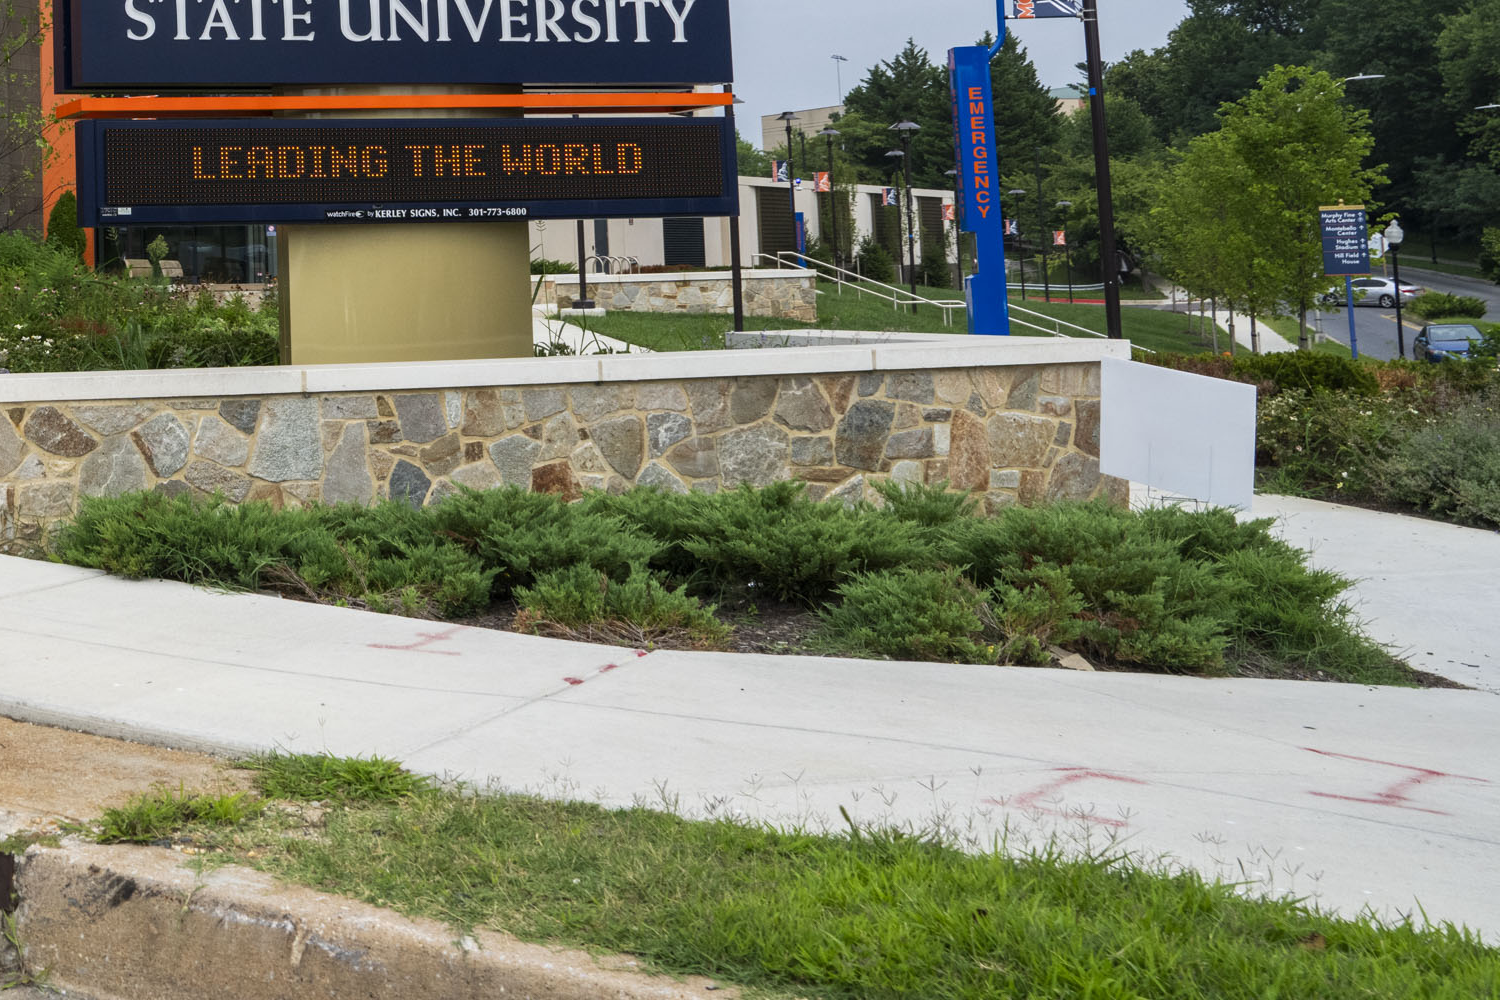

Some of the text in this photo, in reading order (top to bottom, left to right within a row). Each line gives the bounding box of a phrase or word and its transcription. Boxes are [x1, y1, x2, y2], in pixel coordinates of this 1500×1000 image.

[192, 143, 643, 179] LEADING THE WORLD
[968, 87, 990, 219] EMERGENCY
[326, 210, 357, 218] watchFire
[375, 209, 407, 218] KERLEY
[410, 208, 440, 218] SIGNS,
[443, 208, 462, 217] INC.
[468, 207, 527, 217] 301-773-6800
[1321, 212, 1343, 220] Murphy
